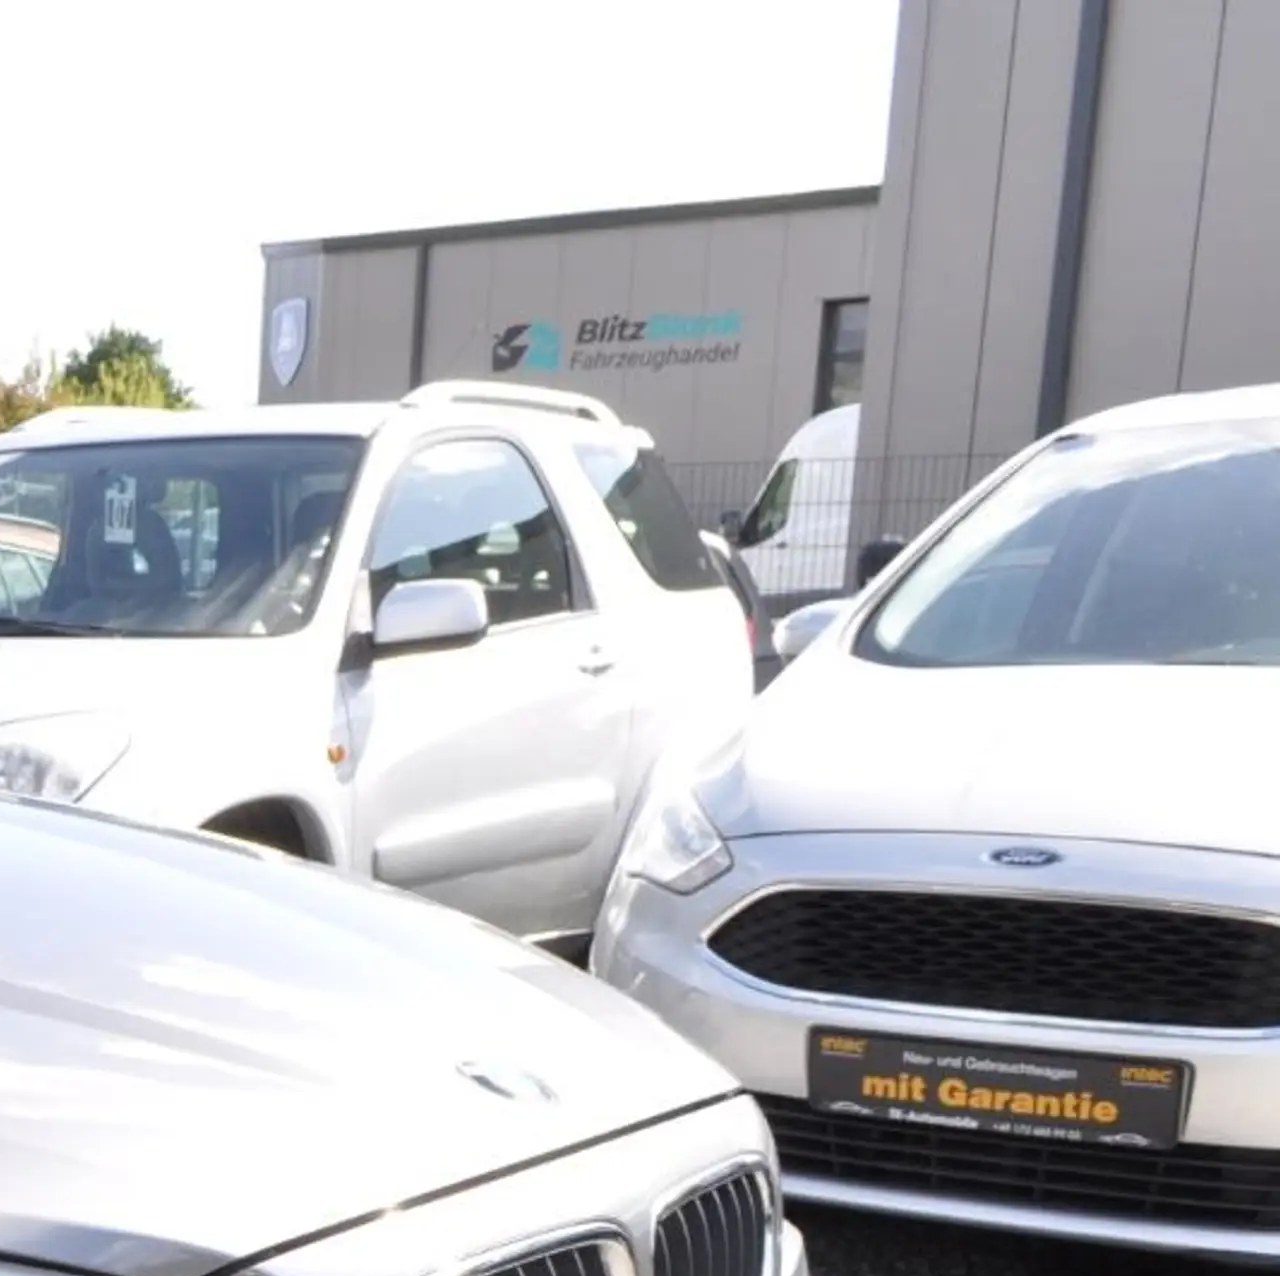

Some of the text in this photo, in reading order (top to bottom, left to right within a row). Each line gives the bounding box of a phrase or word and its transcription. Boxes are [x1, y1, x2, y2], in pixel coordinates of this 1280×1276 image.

[570, 343, 742, 374] Fahrzeughandel
[862, 1072, 1119, 1124] mit Garantie
